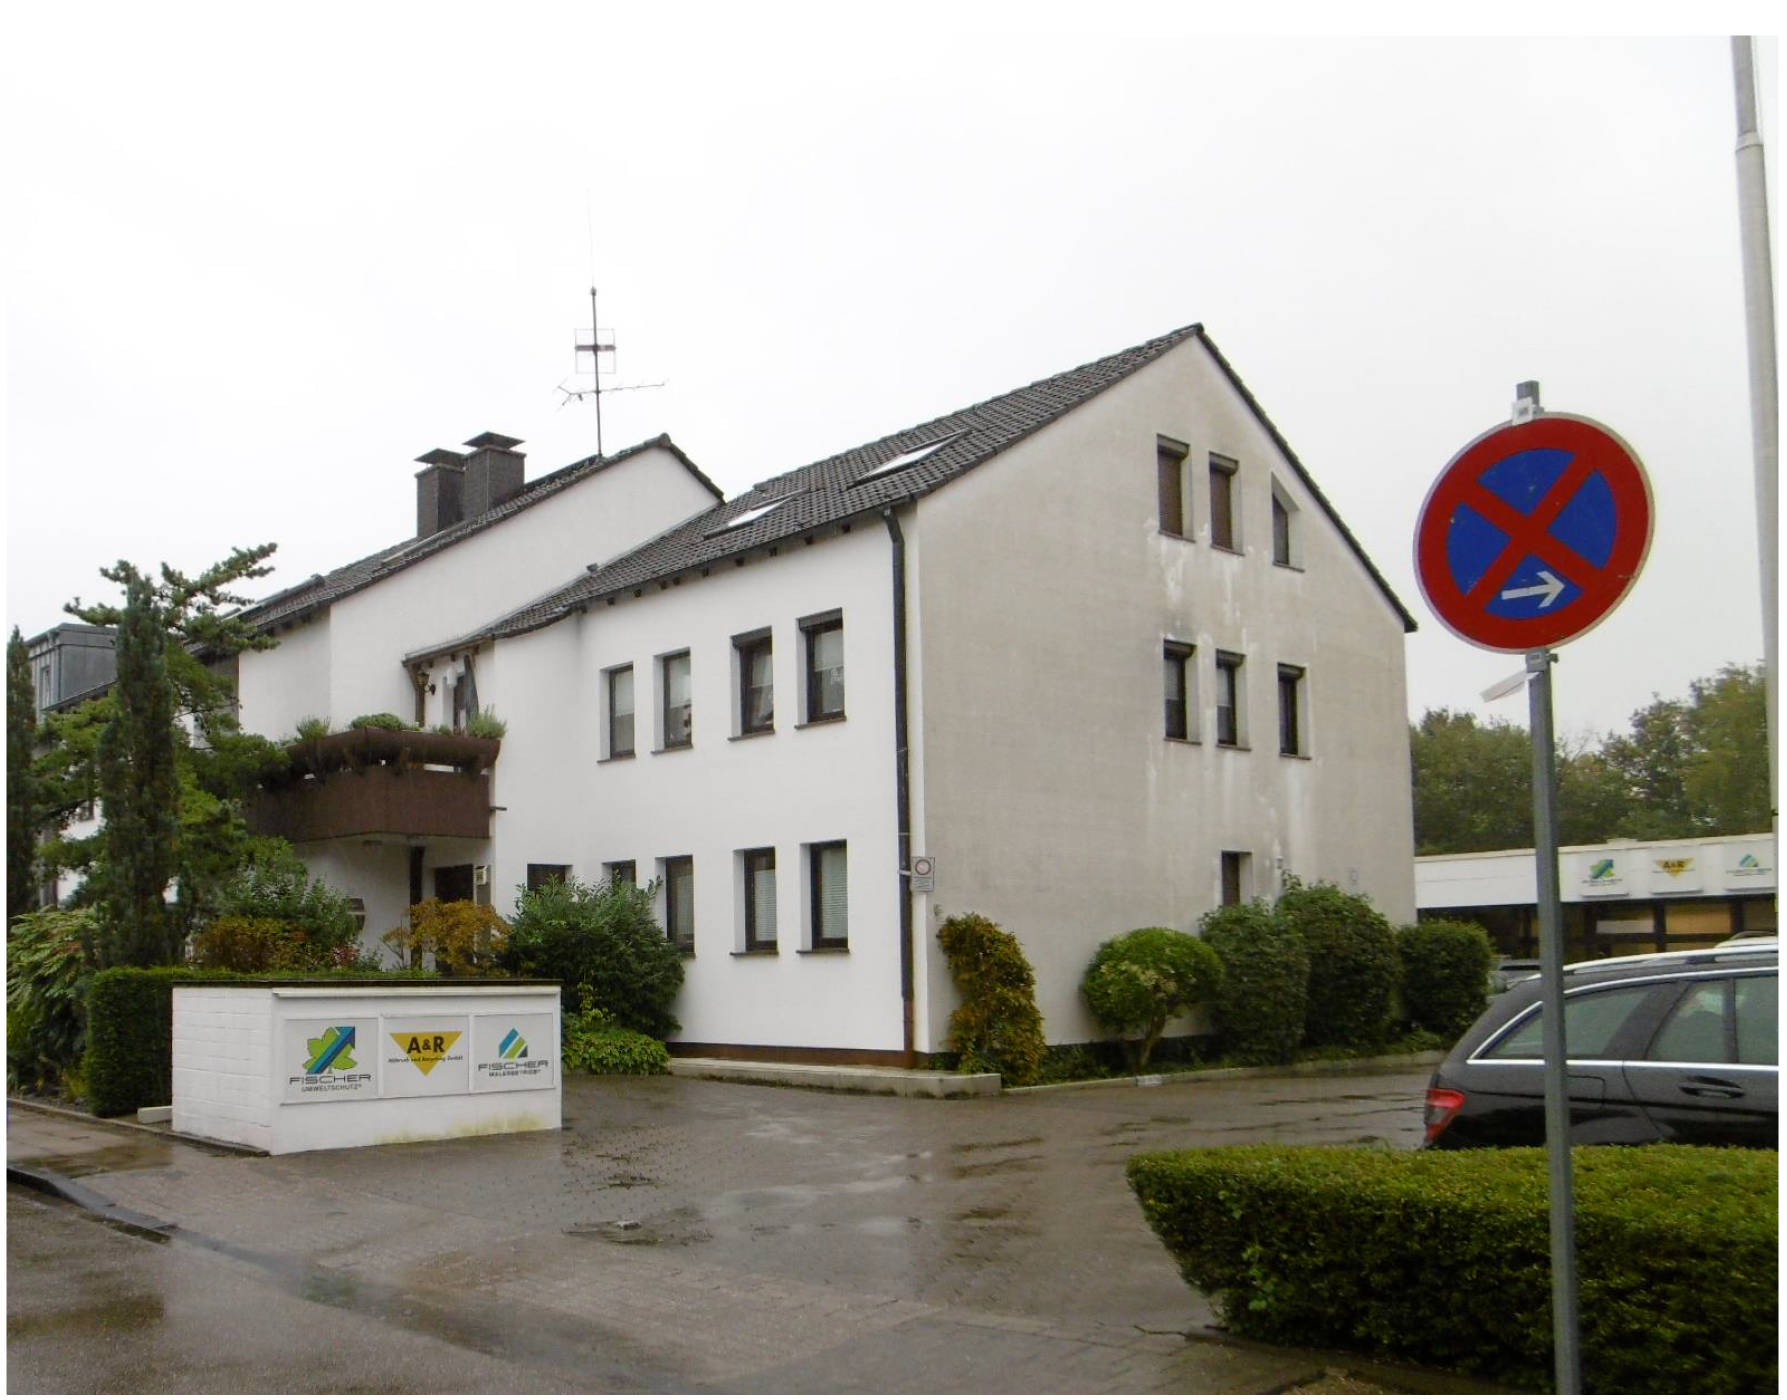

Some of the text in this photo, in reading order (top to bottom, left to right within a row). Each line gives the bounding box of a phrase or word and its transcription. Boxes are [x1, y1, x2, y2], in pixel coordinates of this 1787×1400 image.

[406, 1035, 446, 1054] A&R
[478, 1059, 549, 1072] FISCHER
[289, 1073, 372, 1086] FISCHER
